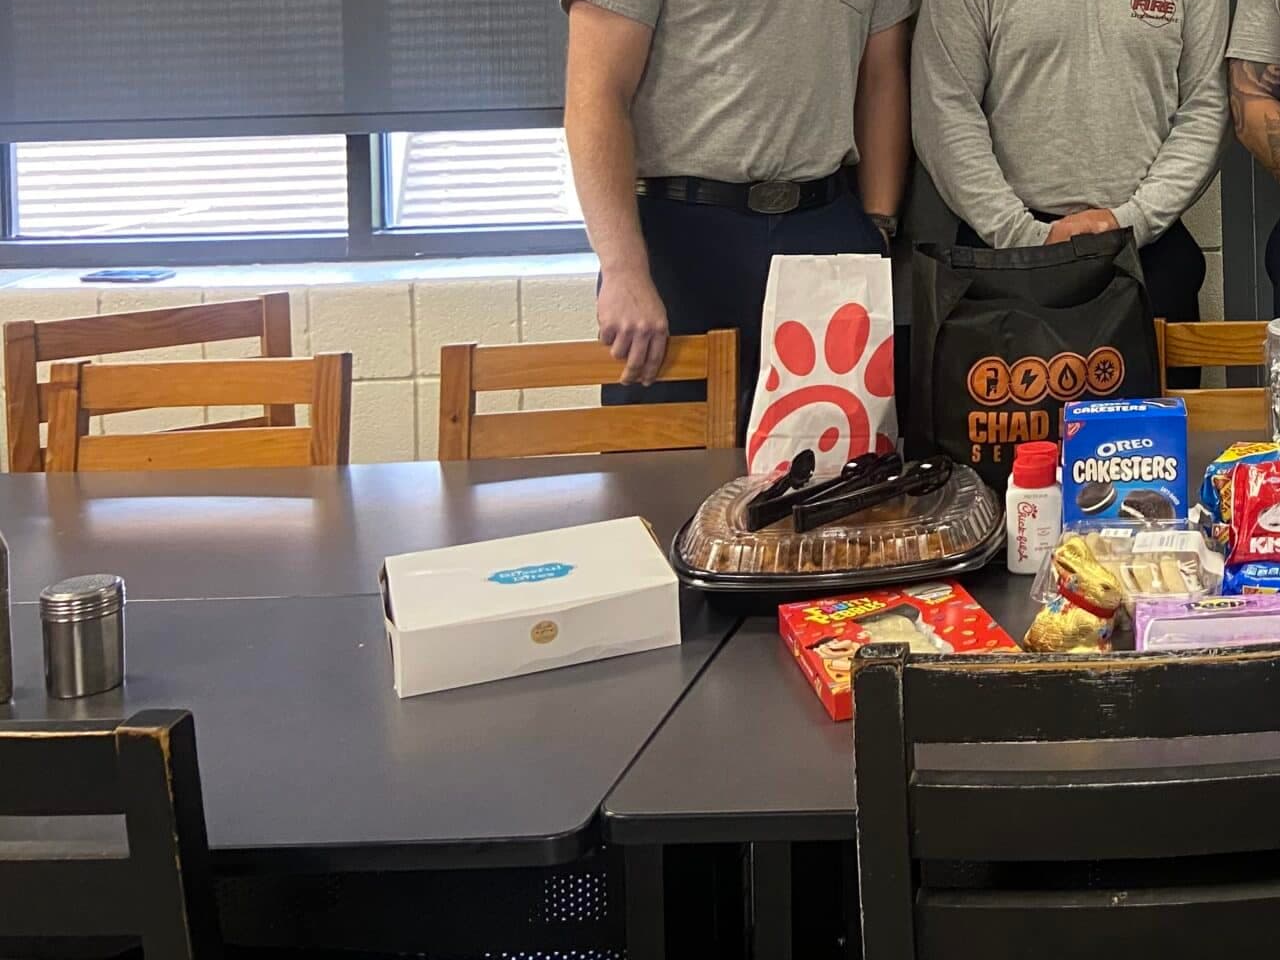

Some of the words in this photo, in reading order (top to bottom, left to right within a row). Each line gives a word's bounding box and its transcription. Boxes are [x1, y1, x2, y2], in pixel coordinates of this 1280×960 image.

[1133, 0, 1175, 13] FIRE
[1072, 405, 1148, 415] CAKESTERS
[968, 410, 1049, 443] CHAD
[1096, 438, 1154, 457] OREO
[1072, 455, 1178, 484] CAKESTERS
